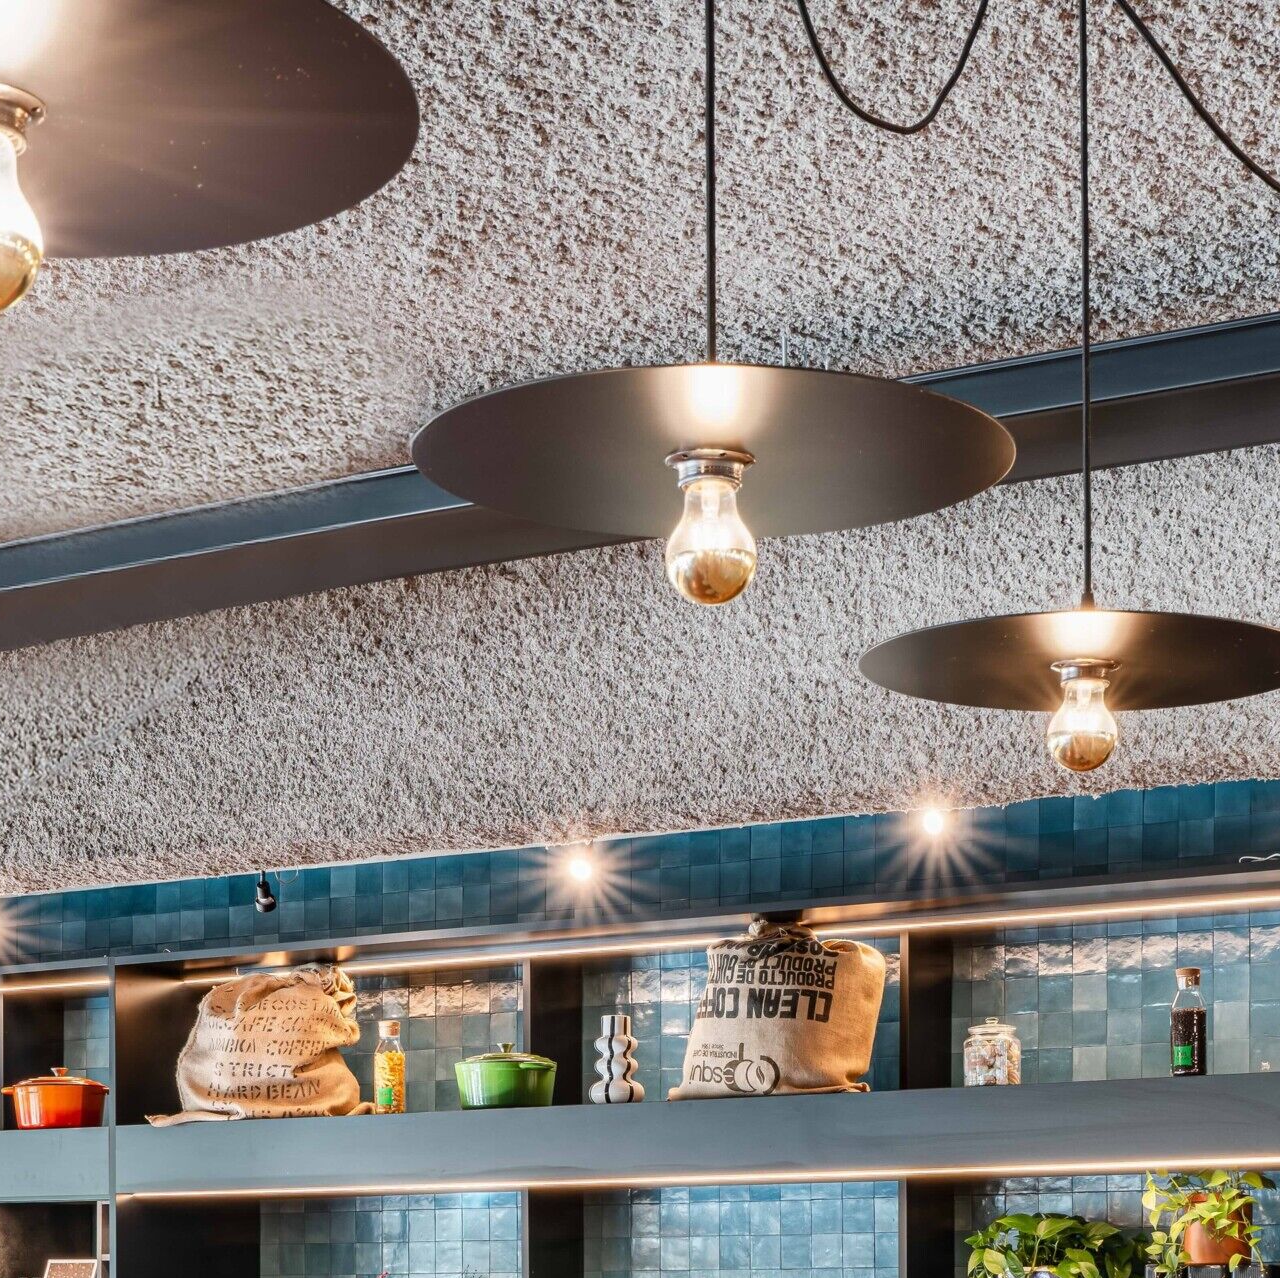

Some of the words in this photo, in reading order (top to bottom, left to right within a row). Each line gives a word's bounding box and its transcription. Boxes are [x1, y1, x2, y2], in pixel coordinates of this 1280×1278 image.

[760, 955, 838, 976] PRODUCT
[736, 969, 755, 985] DE
[758, 970, 835, 990] PRODUCTO
[747, 988, 834, 1023] CLEAN
[207, 1082, 261, 1100] HARD
[265, 1079, 321, 1100] BEAN
